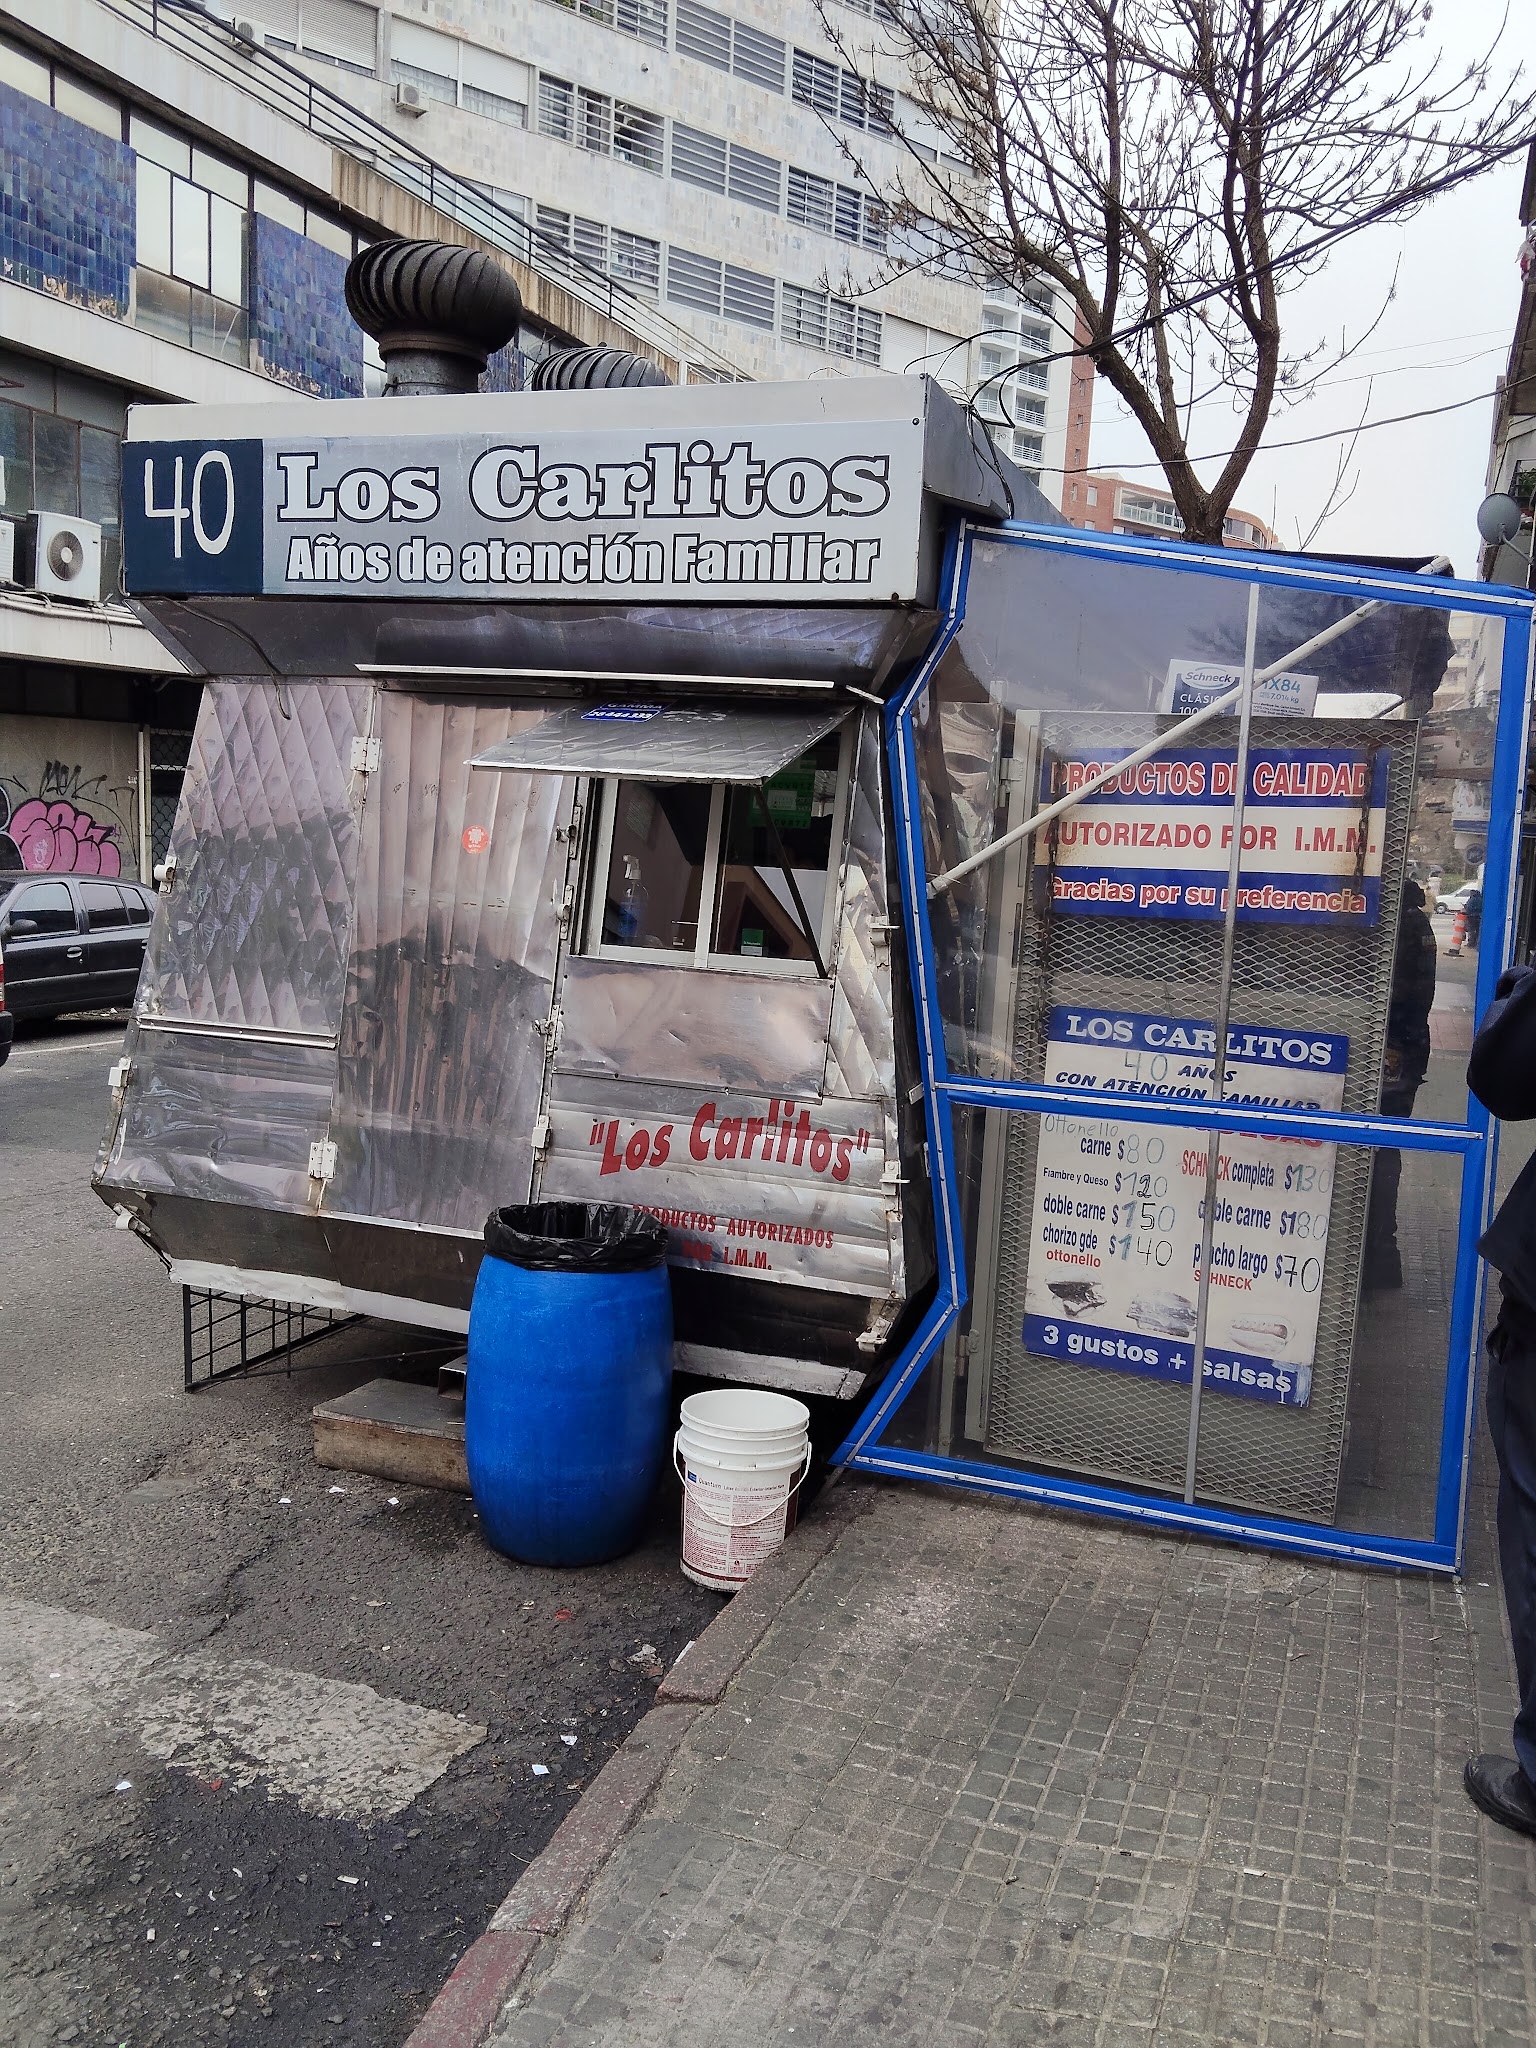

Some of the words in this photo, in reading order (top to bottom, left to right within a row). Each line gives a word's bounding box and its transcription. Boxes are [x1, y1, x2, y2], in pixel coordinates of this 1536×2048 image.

[277, 452, 441, 523] Los
[469, 440, 891, 522] Carlitos
[144, 450, 235, 558] 40
[285, 532, 391, 583] Años
[396, 535, 452, 583] de
[459, 532, 664, 584] atención
[672, 532, 881, 584] Familiar
[1185, 671, 1232, 684] Schneck
[1270, 692, 1289, 702] 7.014
[1290, 695, 1299, 704] kg
[1253, 762, 1370, 797] CALIDAD
[1052, 876, 1135, 901] Gracias
[1140, 884, 1182, 908] por
[1186, 886, 1215, 906] su
[1066, 1014, 1134, 1043] LOS
[1144, 1023, 1333, 1065] CARLITOS
[1124, 1051, 1168, 1082] 40
[1056, 1071, 1097, 1088] CON
[1102, 1077, 1208, 1100] ATENCIÓN
[1044, 1113, 1119, 1136] Ottonello
[1080, 1137, 1112, 1157] carne
[1043, 1167, 1075, 1181] Fiambre
[1076, 1174, 1081, 1184] y
[1083, 1174, 1109, 1187] Queso
[1182, 1150, 1231, 1181] SCHNCK
[1232, 1161, 1274, 1191] completa
[1043, 1193, 1073, 1215] doble
[1076, 1203, 1106, 1221] carne
[727, 1219, 834, 1249] AUTORIZADOS
[1043, 1223, 1077, 1247] chorizo
[1080, 1229, 1098, 1253] gde
[1236, 1206, 1271, 1230] carne
[1279, 1210, 1328, 1240] $180
[1046, 1250, 1101, 1268] ottonello
[1238, 1245, 1268, 1279] largo
[1274, 1254, 1320, 1293] $70
[1194, 1270, 1252, 1291] SHNECK
[1043, 1325, 1059, 1345] 3
[1067, 1333, 1159, 1366] gustos
[1203, 1358, 1292, 1393] salsas
